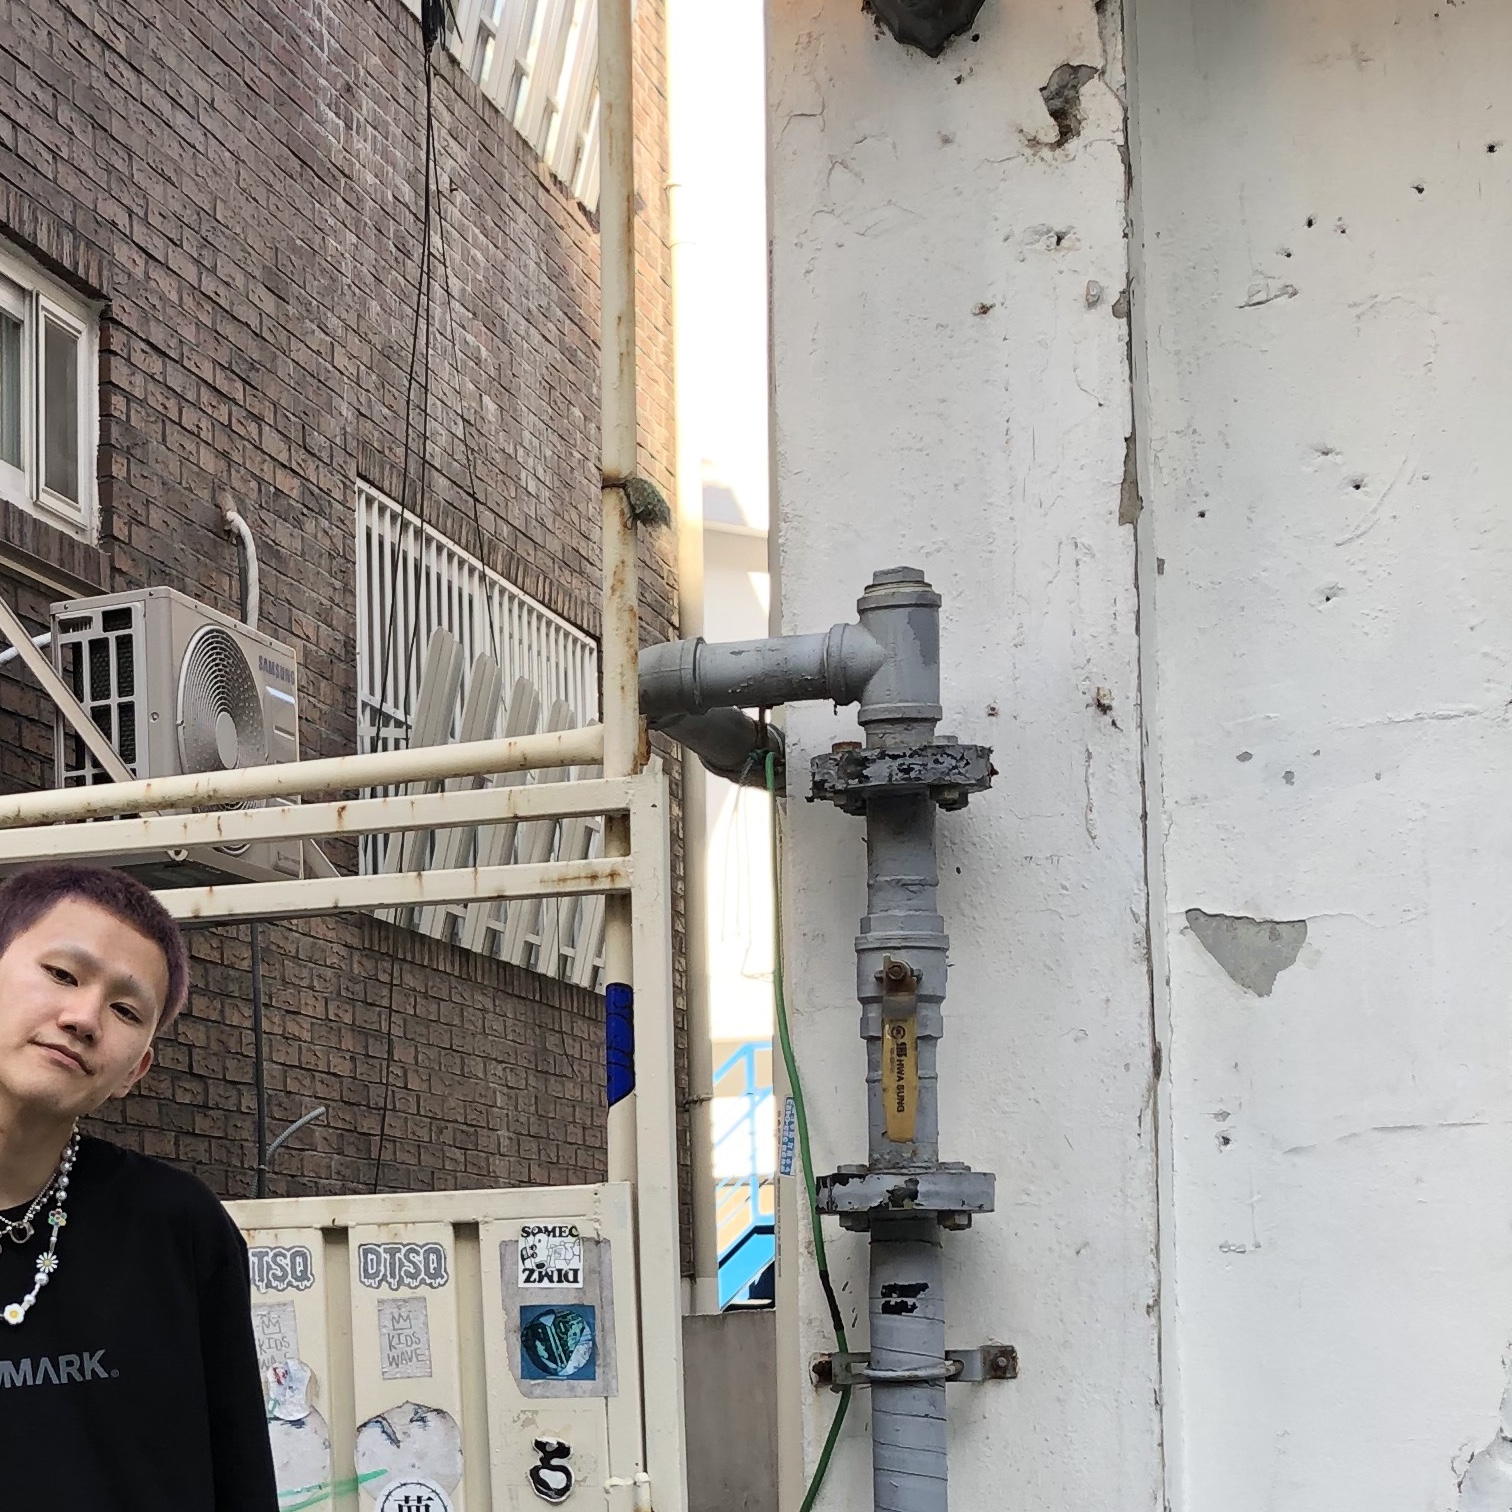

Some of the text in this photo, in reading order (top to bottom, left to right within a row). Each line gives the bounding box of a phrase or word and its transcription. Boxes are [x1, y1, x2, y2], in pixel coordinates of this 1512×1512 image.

[259, 655, 295, 685] SAMSUNG
[359, 1243, 449, 1291] DTSQ
[388, 1331, 421, 1352] KIDS
[387, 1349, 427, 1368] WAVE
